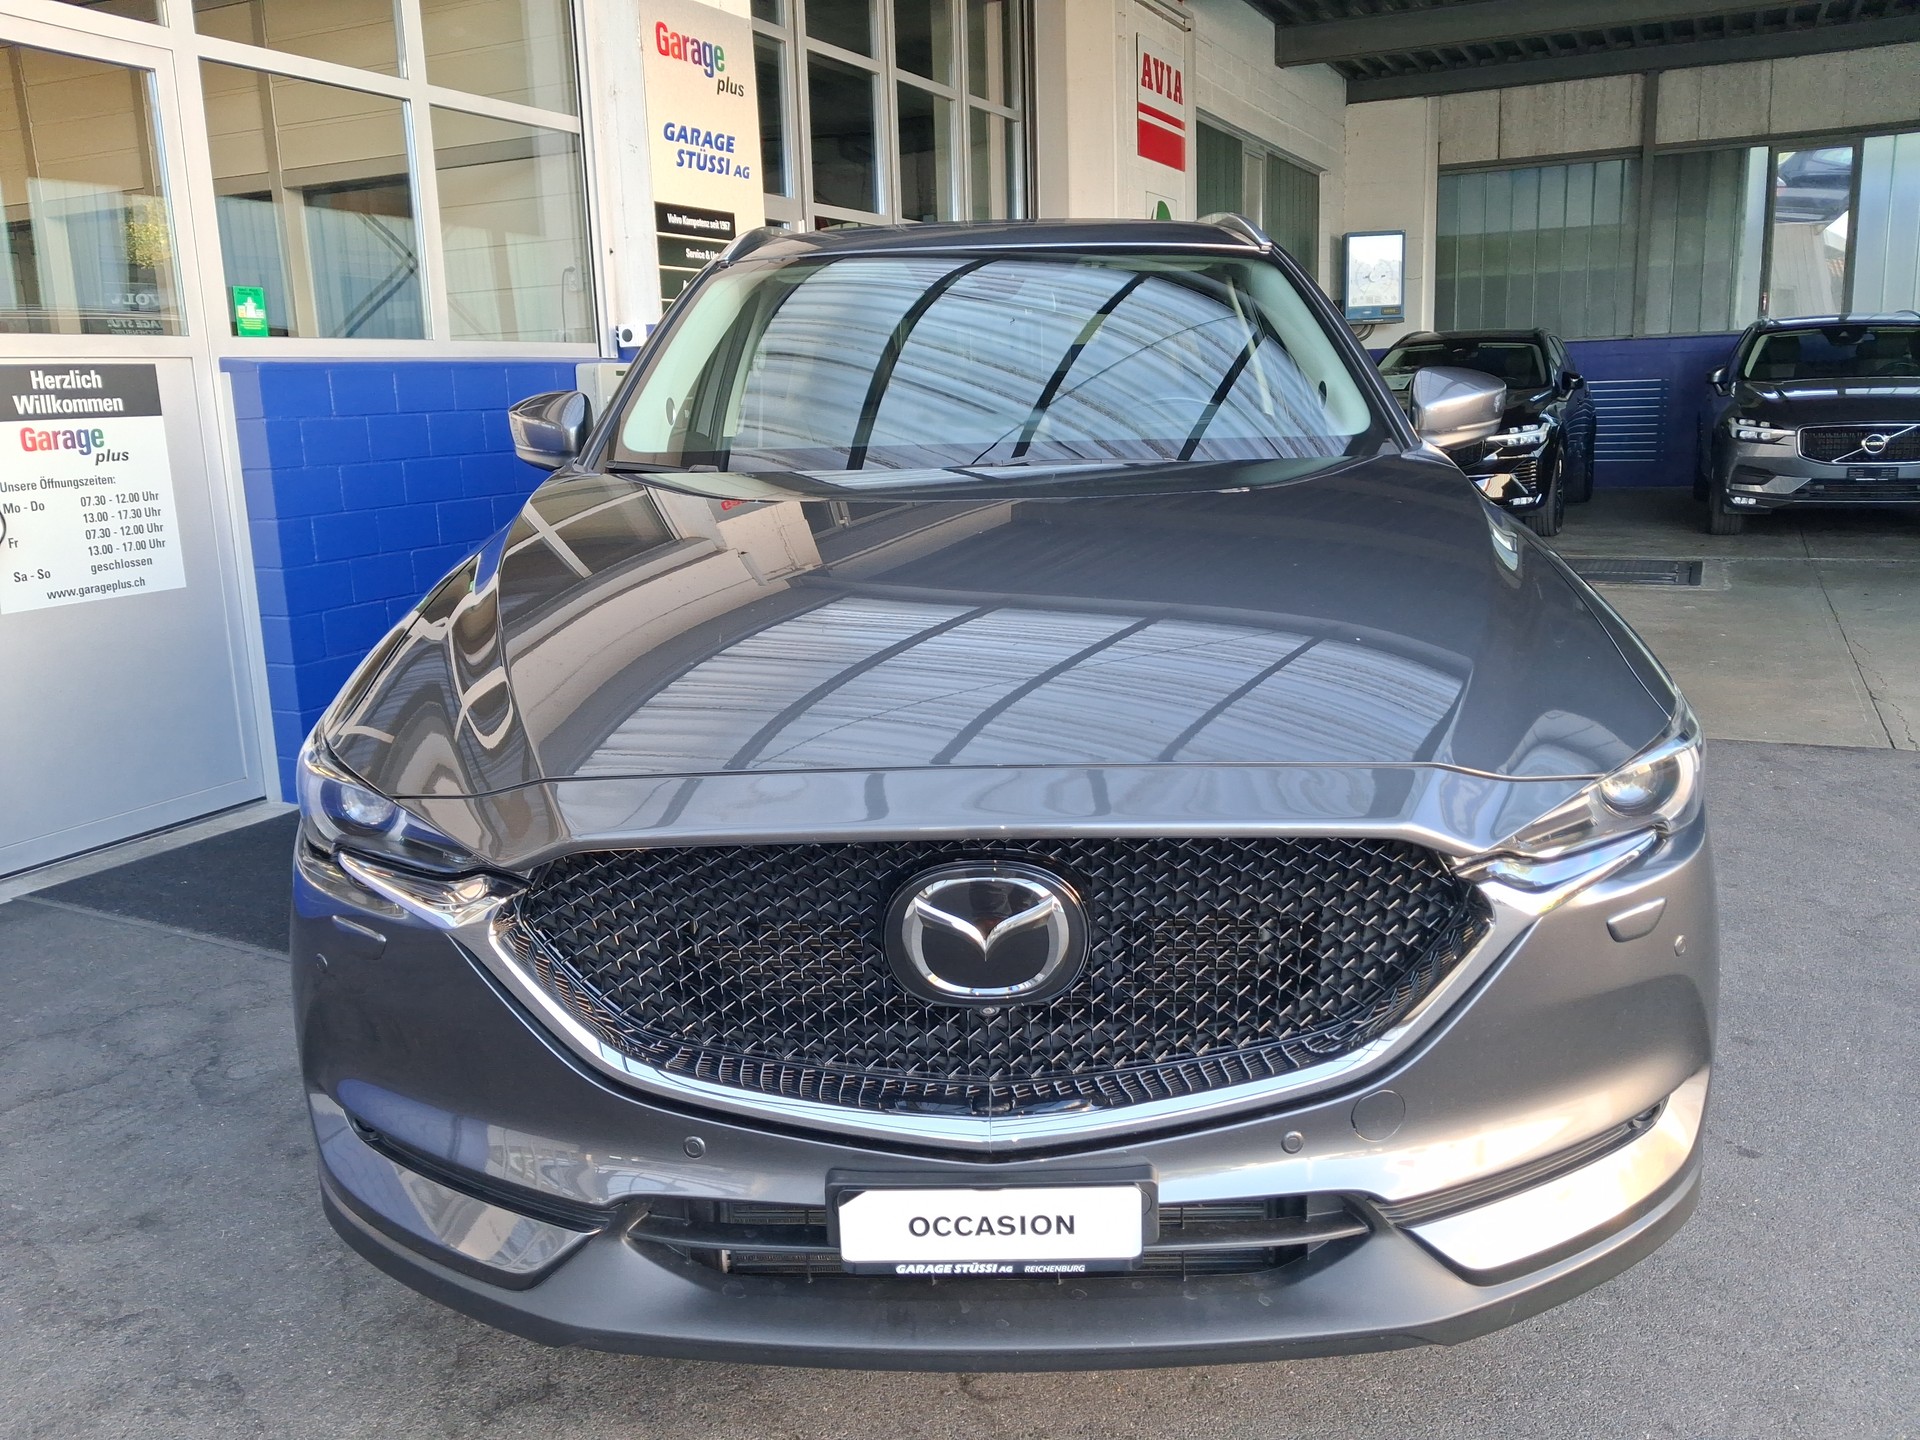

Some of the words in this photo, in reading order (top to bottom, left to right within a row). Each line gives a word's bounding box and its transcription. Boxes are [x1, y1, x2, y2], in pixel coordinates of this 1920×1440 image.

[655, 21, 725, 78] Garage
[717, 76, 745, 97] plus
[1141, 52, 1184, 106] AVIA
[663, 122, 736, 153] GARAGE
[676, 149, 731, 175] STÜSSI
[734, 165, 750, 180] AG
[666, 213, 682, 224] Volvo
[682, 215, 710, 228] Kompetenz
[710, 220, 719, 229] seit
[685, 248, 705, 259] Service
[30, 370, 103, 389] Herzlich
[12, 395, 124, 415] Willkommen
[20, 427, 105, 456] Garage
[95, 449, 129, 466] plus
[0, 481, 37, 493] Unsere
[39, 475, 116, 490] Öffnungszeiten:
[3, 503, 21, 514] Mo
[30, 501, 45, 512] Do
[80, 496, 106, 507] 07.30
[115, 492, 140, 504] 12.00
[142, 491, 159, 502] Uhr
[83, 512, 108, 523] 13.00
[117, 508, 142, 520] 17.30
[144, 507, 162, 517] Uhr
[85, 528, 111, 540] 07.30
[120, 524, 144, 536] 12.00
[146, 523, 164, 533] Uhr
[8, 538, 18, 549] Fr
[88, 545, 113, 556] 13.00
[122, 540, 147, 552] 17.00
[149, 539, 166, 549] Uhr
[13, 571, 28, 583] Sa
[37, 569, 51, 580] So
[90, 556, 153, 574] geschlossen
[46, 577, 146, 600] www.garageplus.ch
[908, 1214, 1076, 1237] OCCASION
[896, 1264, 953, 1274] GARAGE
[952, 1262, 999, 1274] STÜSSI
[999, 1265, 1013, 1273] AG
[1024, 1265, 1086, 1273] REICHENBURG
